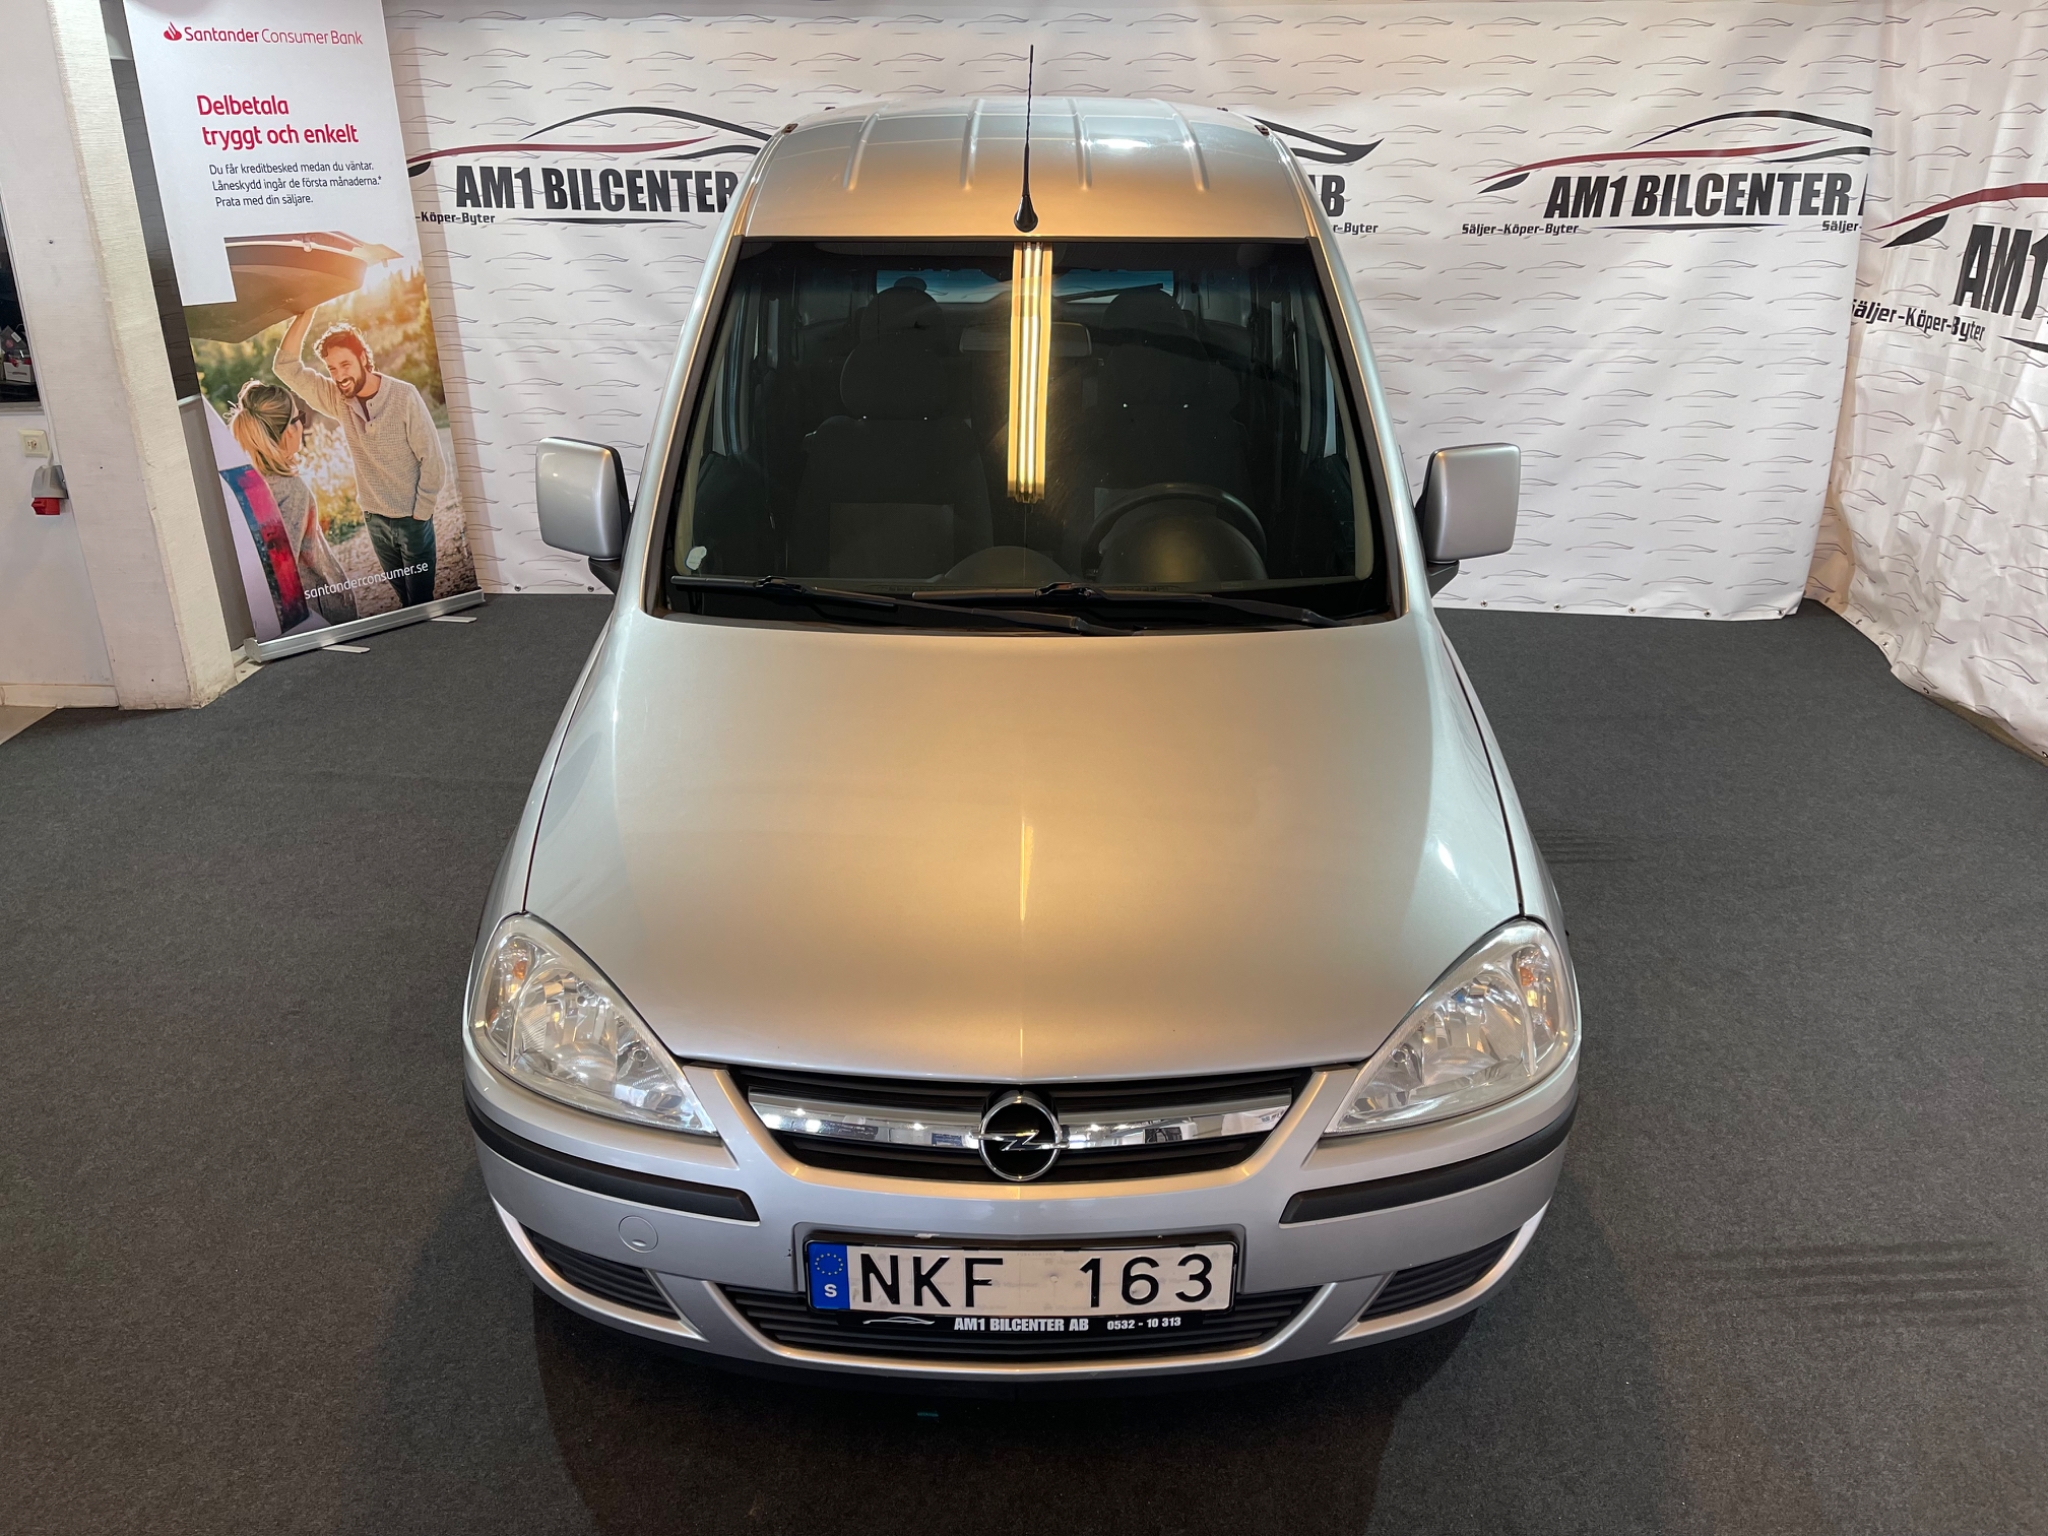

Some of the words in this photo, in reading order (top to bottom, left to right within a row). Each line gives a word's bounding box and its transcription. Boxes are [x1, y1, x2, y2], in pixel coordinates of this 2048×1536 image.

[184, 26, 259, 43] Santander
[261, 28, 328, 44] Consumer
[330, 29, 364, 45] Bank
[197, 94, 289, 115] Delbetala
[201, 125, 263, 151] tryggt
[266, 123, 300, 144] och
[303, 123, 359, 144] enkelt
[209, 164, 223, 175] Du
[225, 163, 238, 175] får
[240, 162, 299, 174] kreditbesked
[300, 161, 331, 172] medan
[332, 161, 344, 172] du
[345, 160, 374, 171] väntar.
[212, 180, 262, 193] Låneskydd
[263, 179, 286, 192] ingår
[288, 178, 301, 189] de
[302, 178, 328, 188] första
[456, 165, 535, 210] AM1
[541, 168, 738, 213] BILCENTER
[215, 196, 241, 208] Prata
[243, 195, 264, 206] med
[265, 194, 281, 205] din
[282, 194, 314, 206] säljare.
[1543, 175, 1628, 219] AM1
[1632, 173, 1853, 217] BILCENTER
[1462, 223, 1580, 237] Säljer-Köper-Byter
[1953, 224, 2048, 320] AM1
[304, 562, 429, 600] santanderconsumer.se
[860, 1253, 1003, 1308] NKF
[1079, 1253, 1213, 1307] 163
[823, 1283, 838, 1298] S
[953, 1317, 986, 1331] AM1
[989, 1318, 1065, 1332] BILCENTER
[1069, 1318, 1089, 1332] AB
[1107, 1319, 1136, 1330] 0532
[1147, 1318, 1159, 1328] 10
[1161, 1317, 1182, 1327] 313
